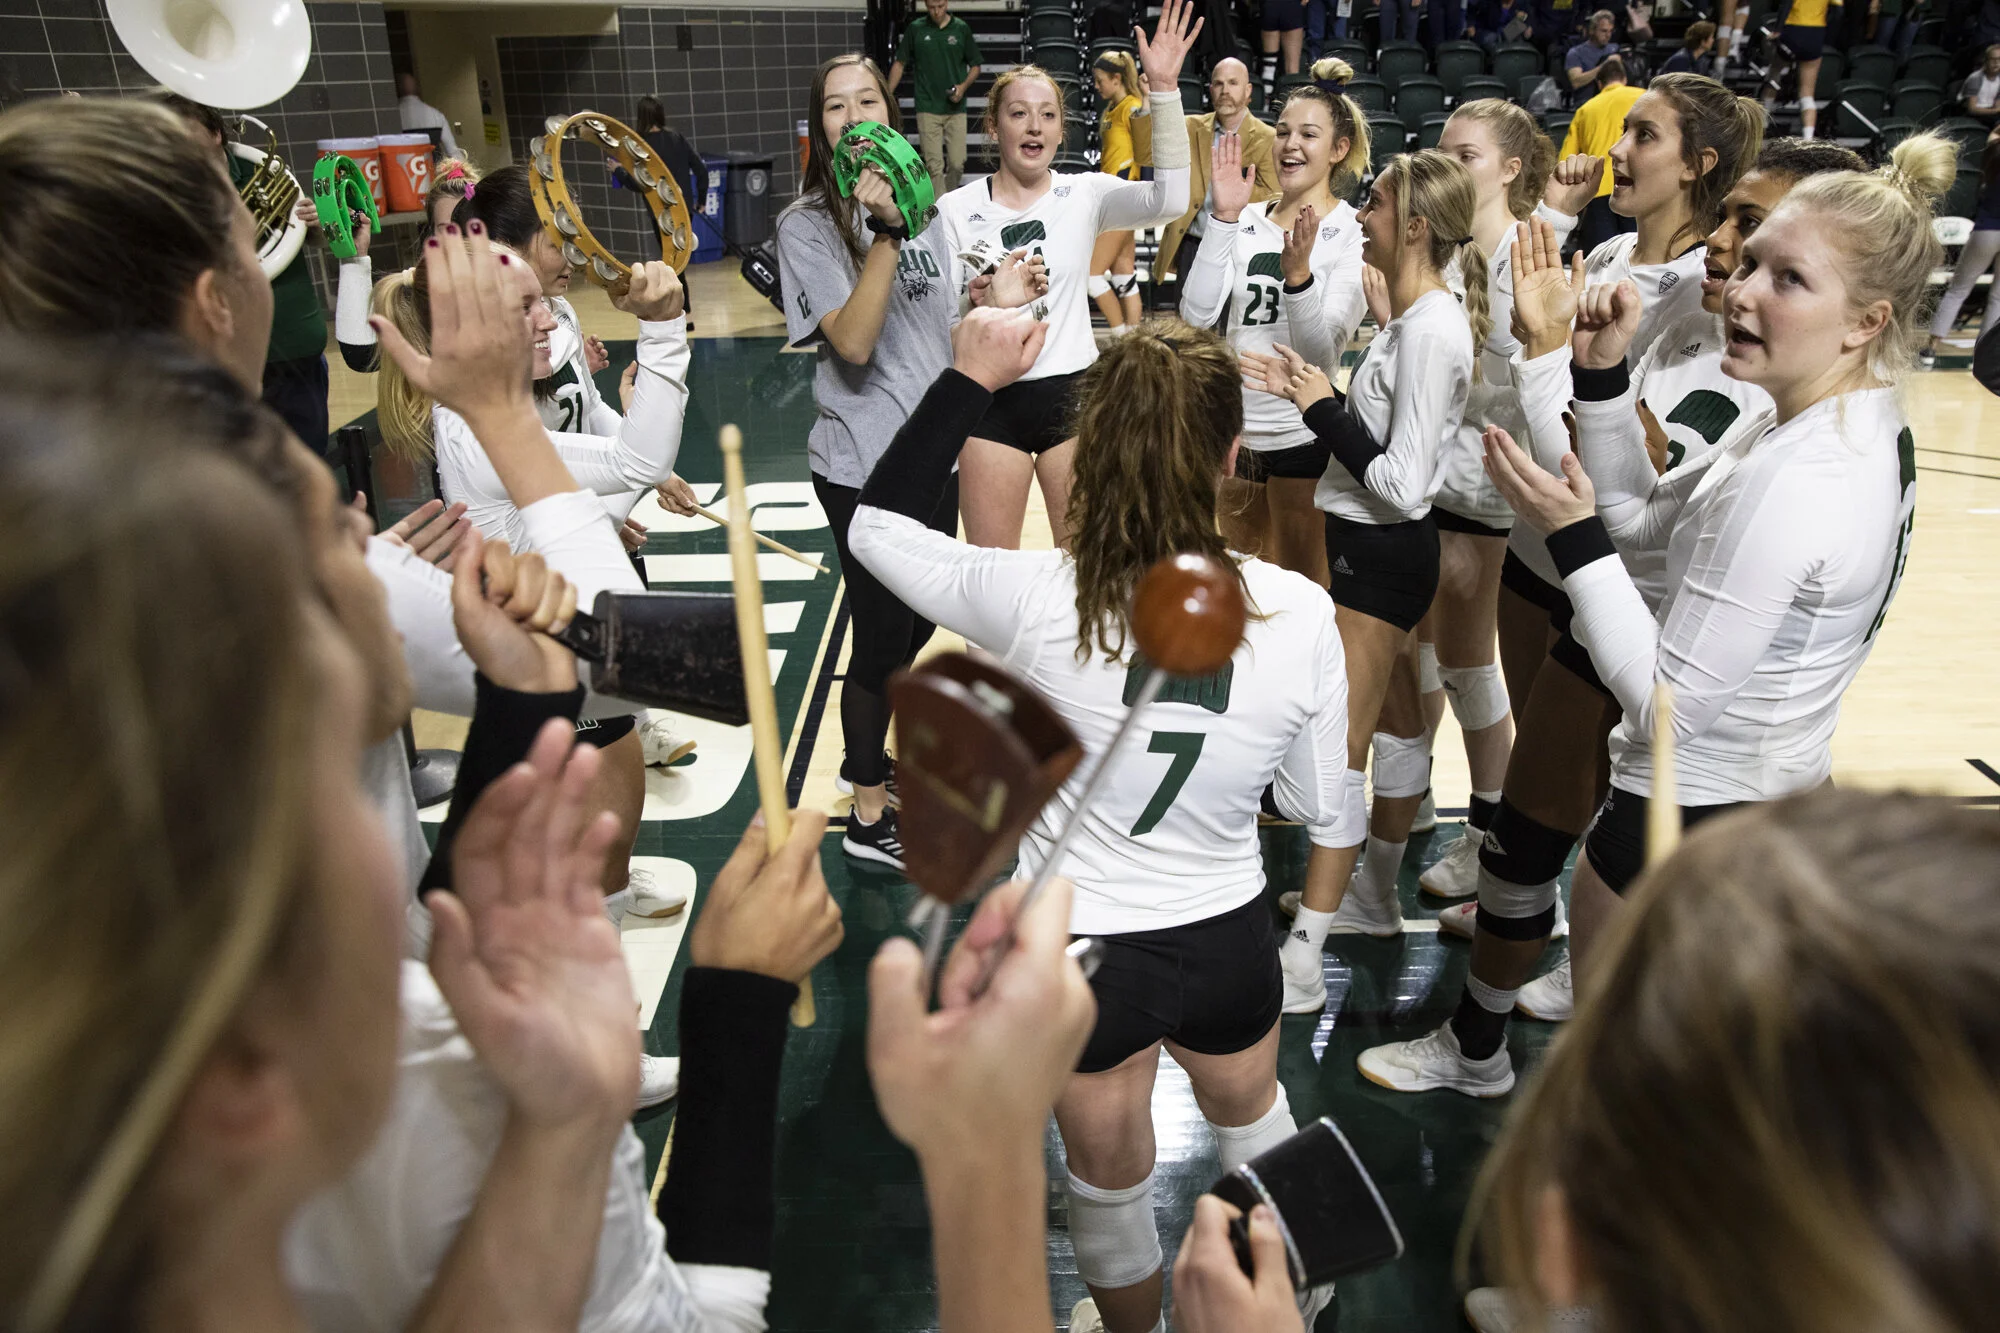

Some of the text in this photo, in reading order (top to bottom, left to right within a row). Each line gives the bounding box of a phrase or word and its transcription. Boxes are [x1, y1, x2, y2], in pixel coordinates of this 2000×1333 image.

[365, 160, 379, 181] G
[410, 156, 427, 176] G
[896, 248, 940, 278] HIO
[797, 290, 812, 320] 12
[1242, 283, 1279, 326] 23
[559, 391, 584, 434] 21
[1130, 731, 1206, 837] 7
